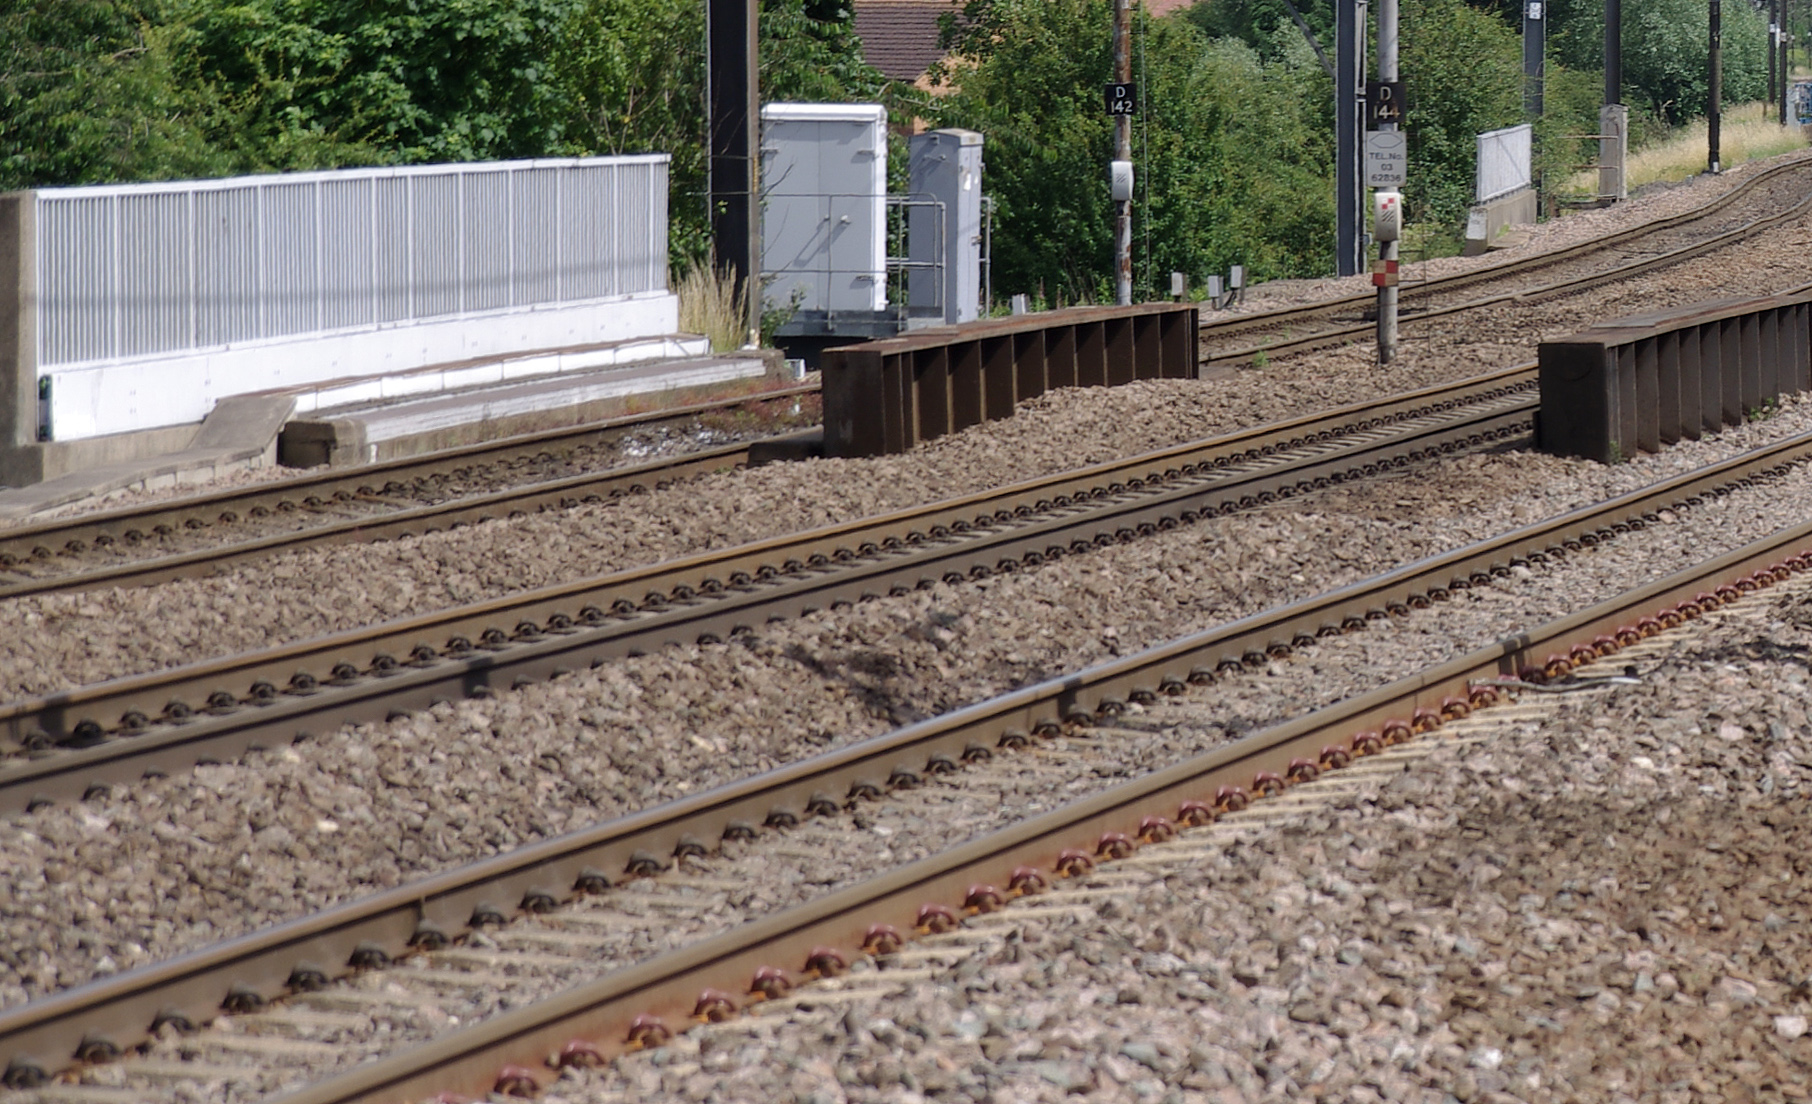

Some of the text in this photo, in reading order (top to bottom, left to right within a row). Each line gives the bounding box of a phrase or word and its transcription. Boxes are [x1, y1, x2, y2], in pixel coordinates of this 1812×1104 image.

[1115, 86, 1126, 98] D
[1379, 86, 1392, 101] D
[1110, 100, 1133, 113] 142
[1373, 104, 1401, 120] 144
[1381, 163, 1393, 171] 03
